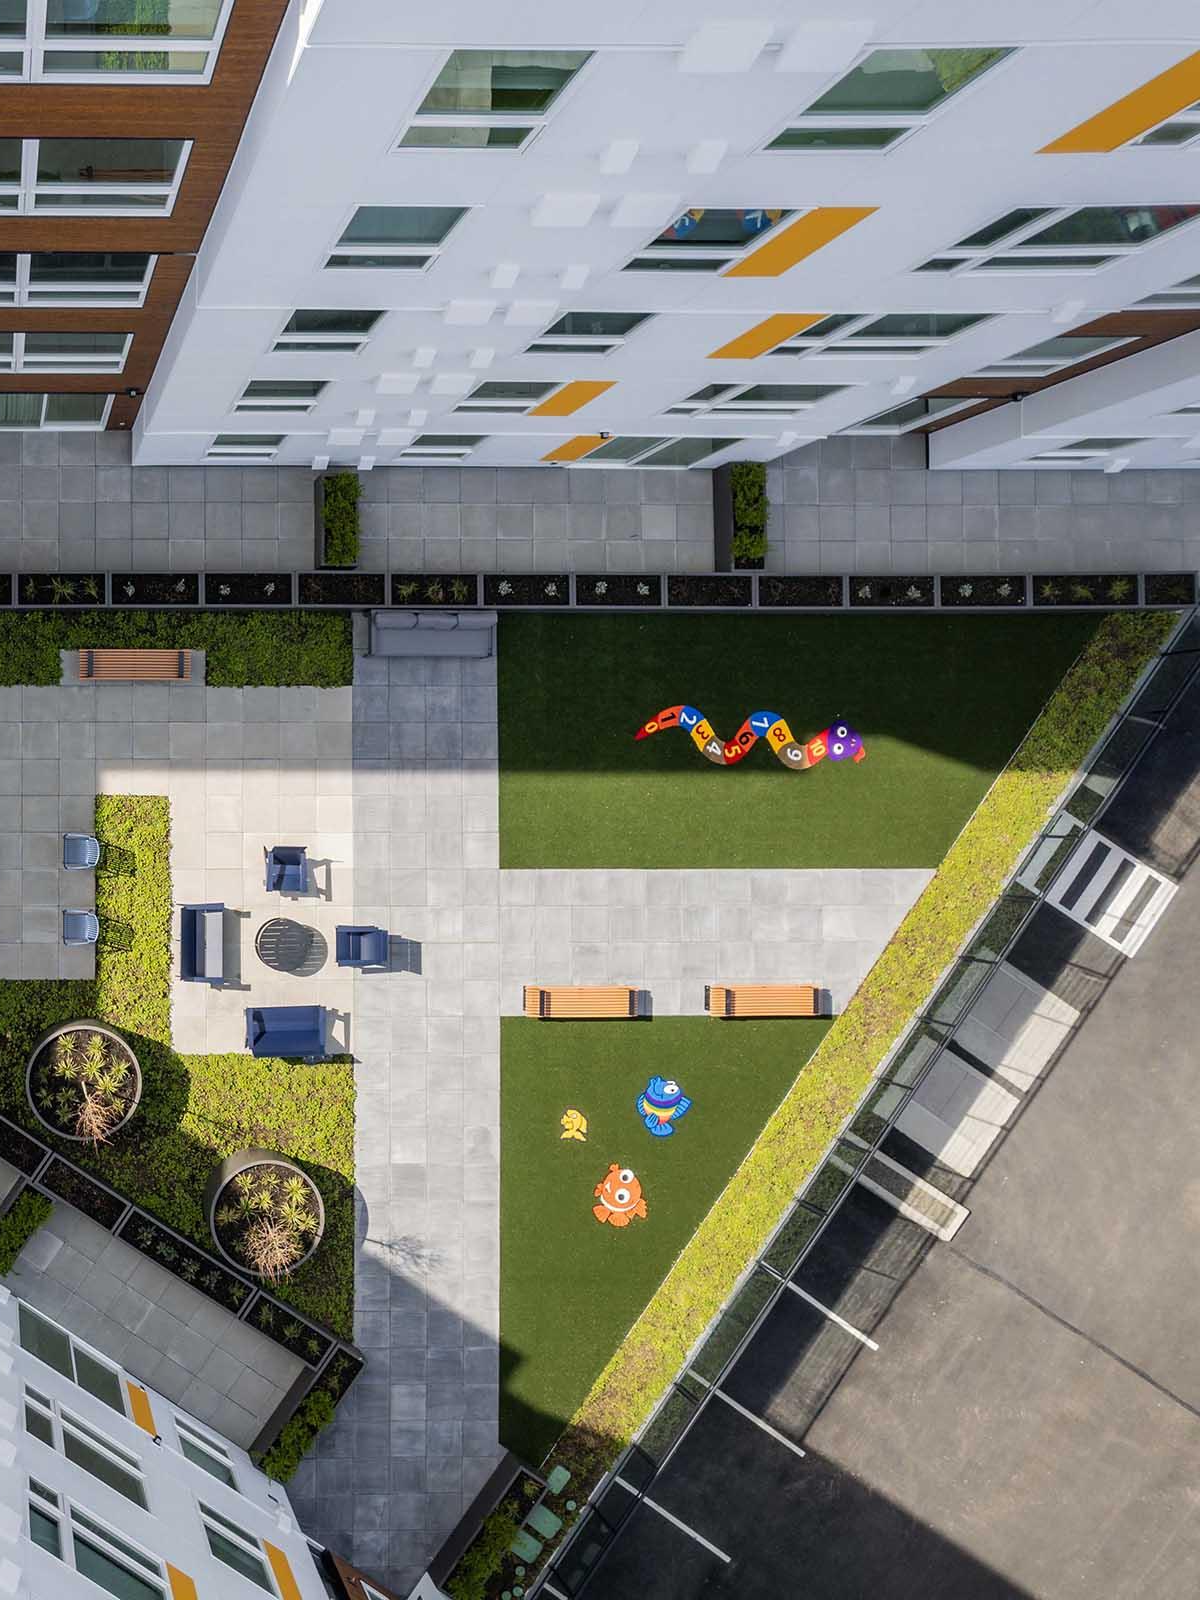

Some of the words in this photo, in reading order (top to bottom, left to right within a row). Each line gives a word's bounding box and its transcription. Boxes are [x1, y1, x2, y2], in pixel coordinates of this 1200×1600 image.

[645, 722, 658, 733] 0
[661, 712, 677, 723] 1
[680, 712, 697, 725] 2
[695, 724, 710, 740] 3
[706, 741, 722, 756] 4
[724, 746, 741, 758] 5
[738, 733, 754, 746] 6
[752, 717, 769, 729] 7
[773, 727, 787, 742] 8
[787, 747, 802, 761] 9
[810, 740, 826, 756] 10
